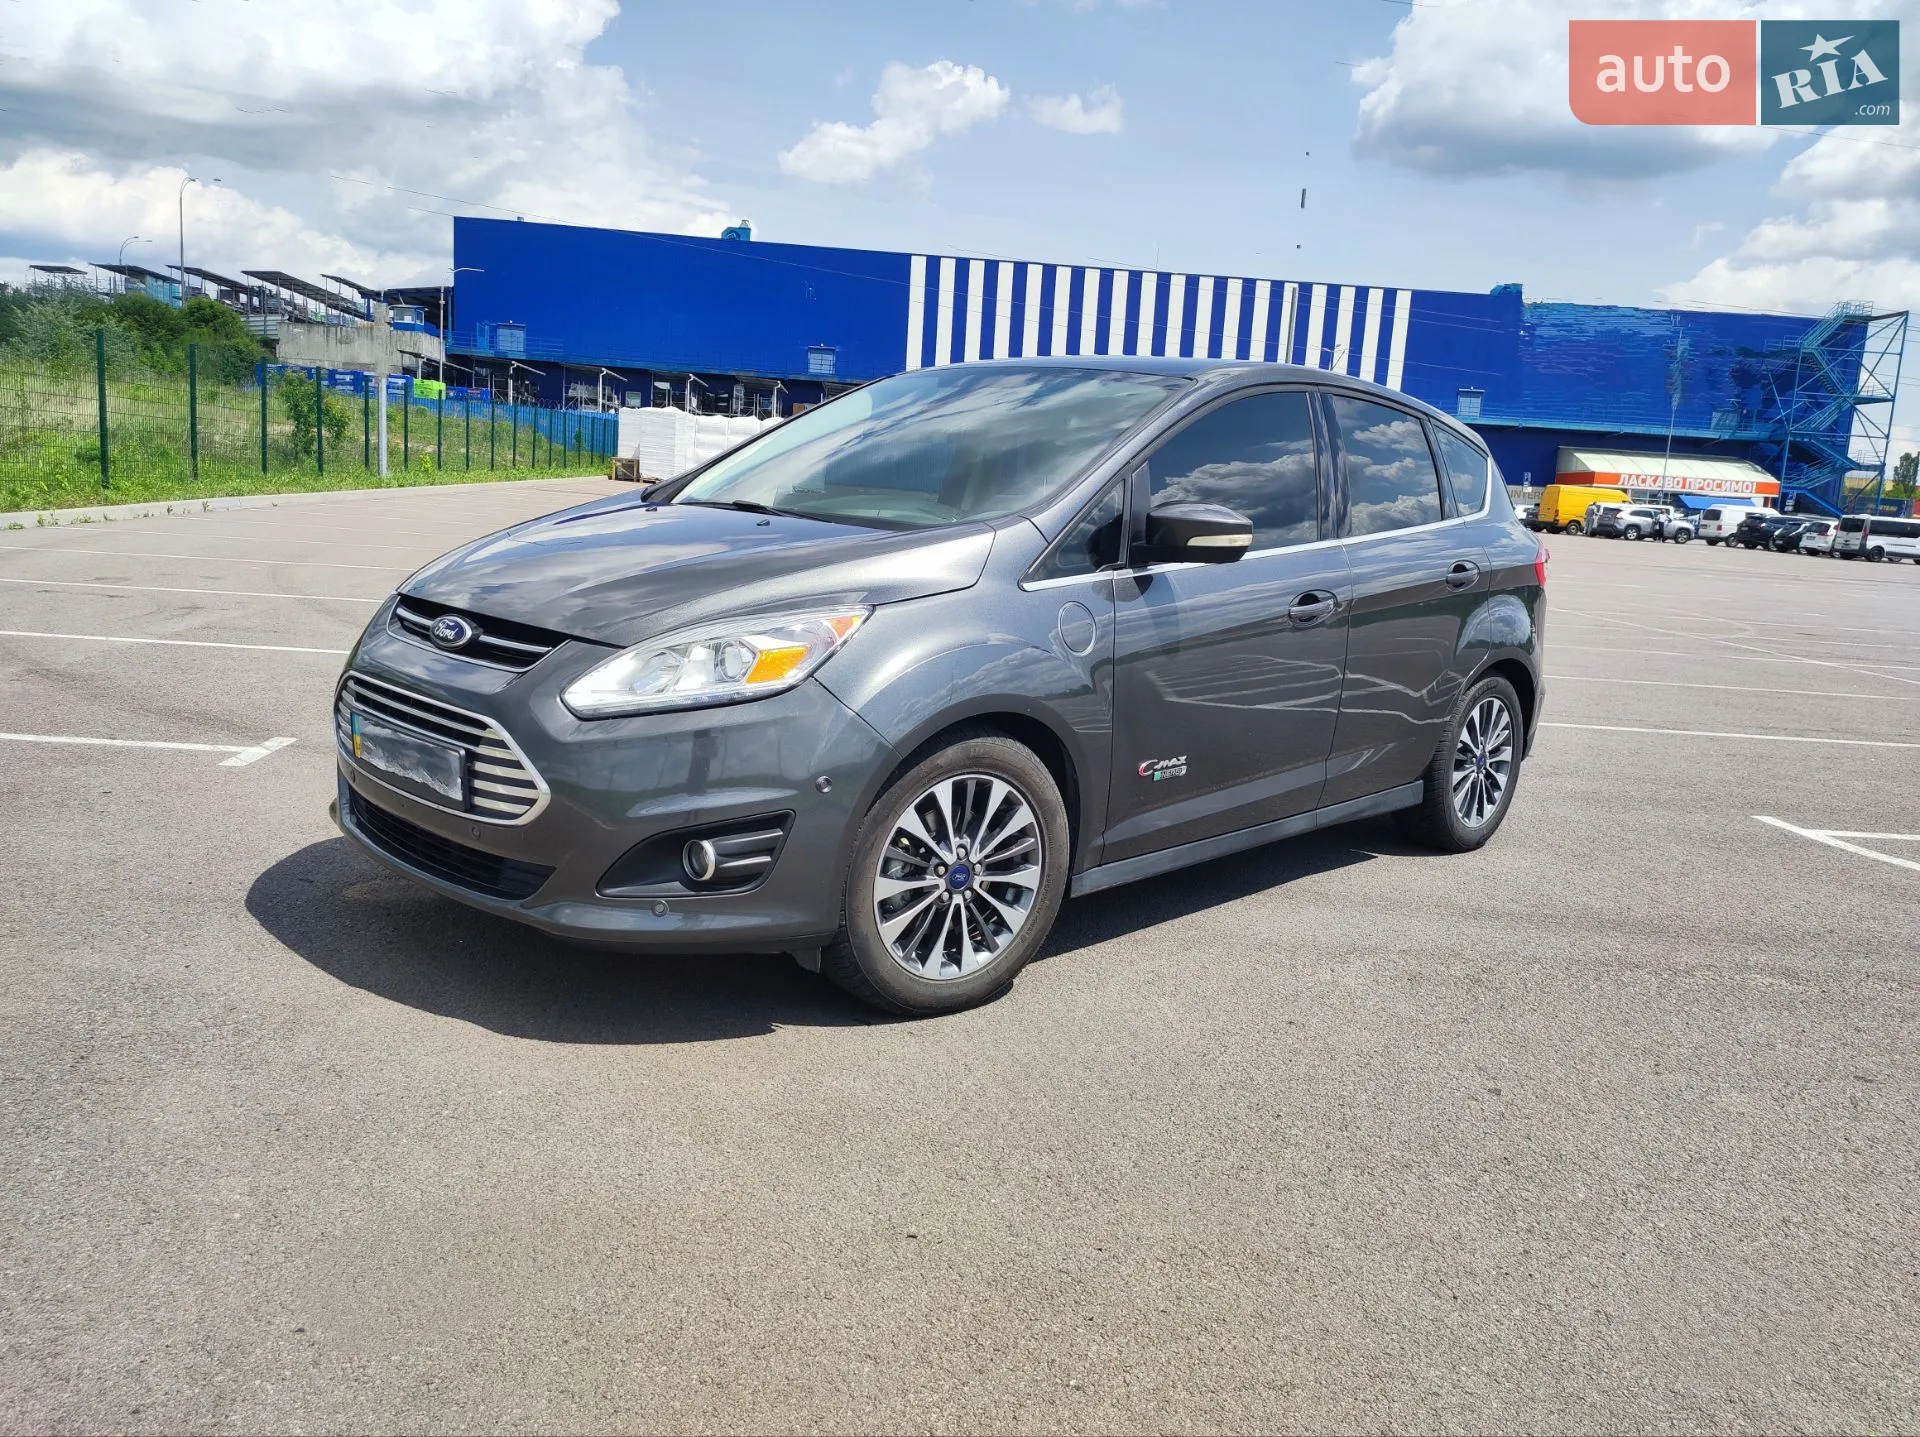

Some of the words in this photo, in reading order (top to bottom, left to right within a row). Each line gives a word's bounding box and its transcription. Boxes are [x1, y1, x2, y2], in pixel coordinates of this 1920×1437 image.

[1618, 474, 1682, 489] ЛАСКАВО
[1685, 478, 1757, 493] ПРОСИМО!
[434, 619, 459, 640] Ford
